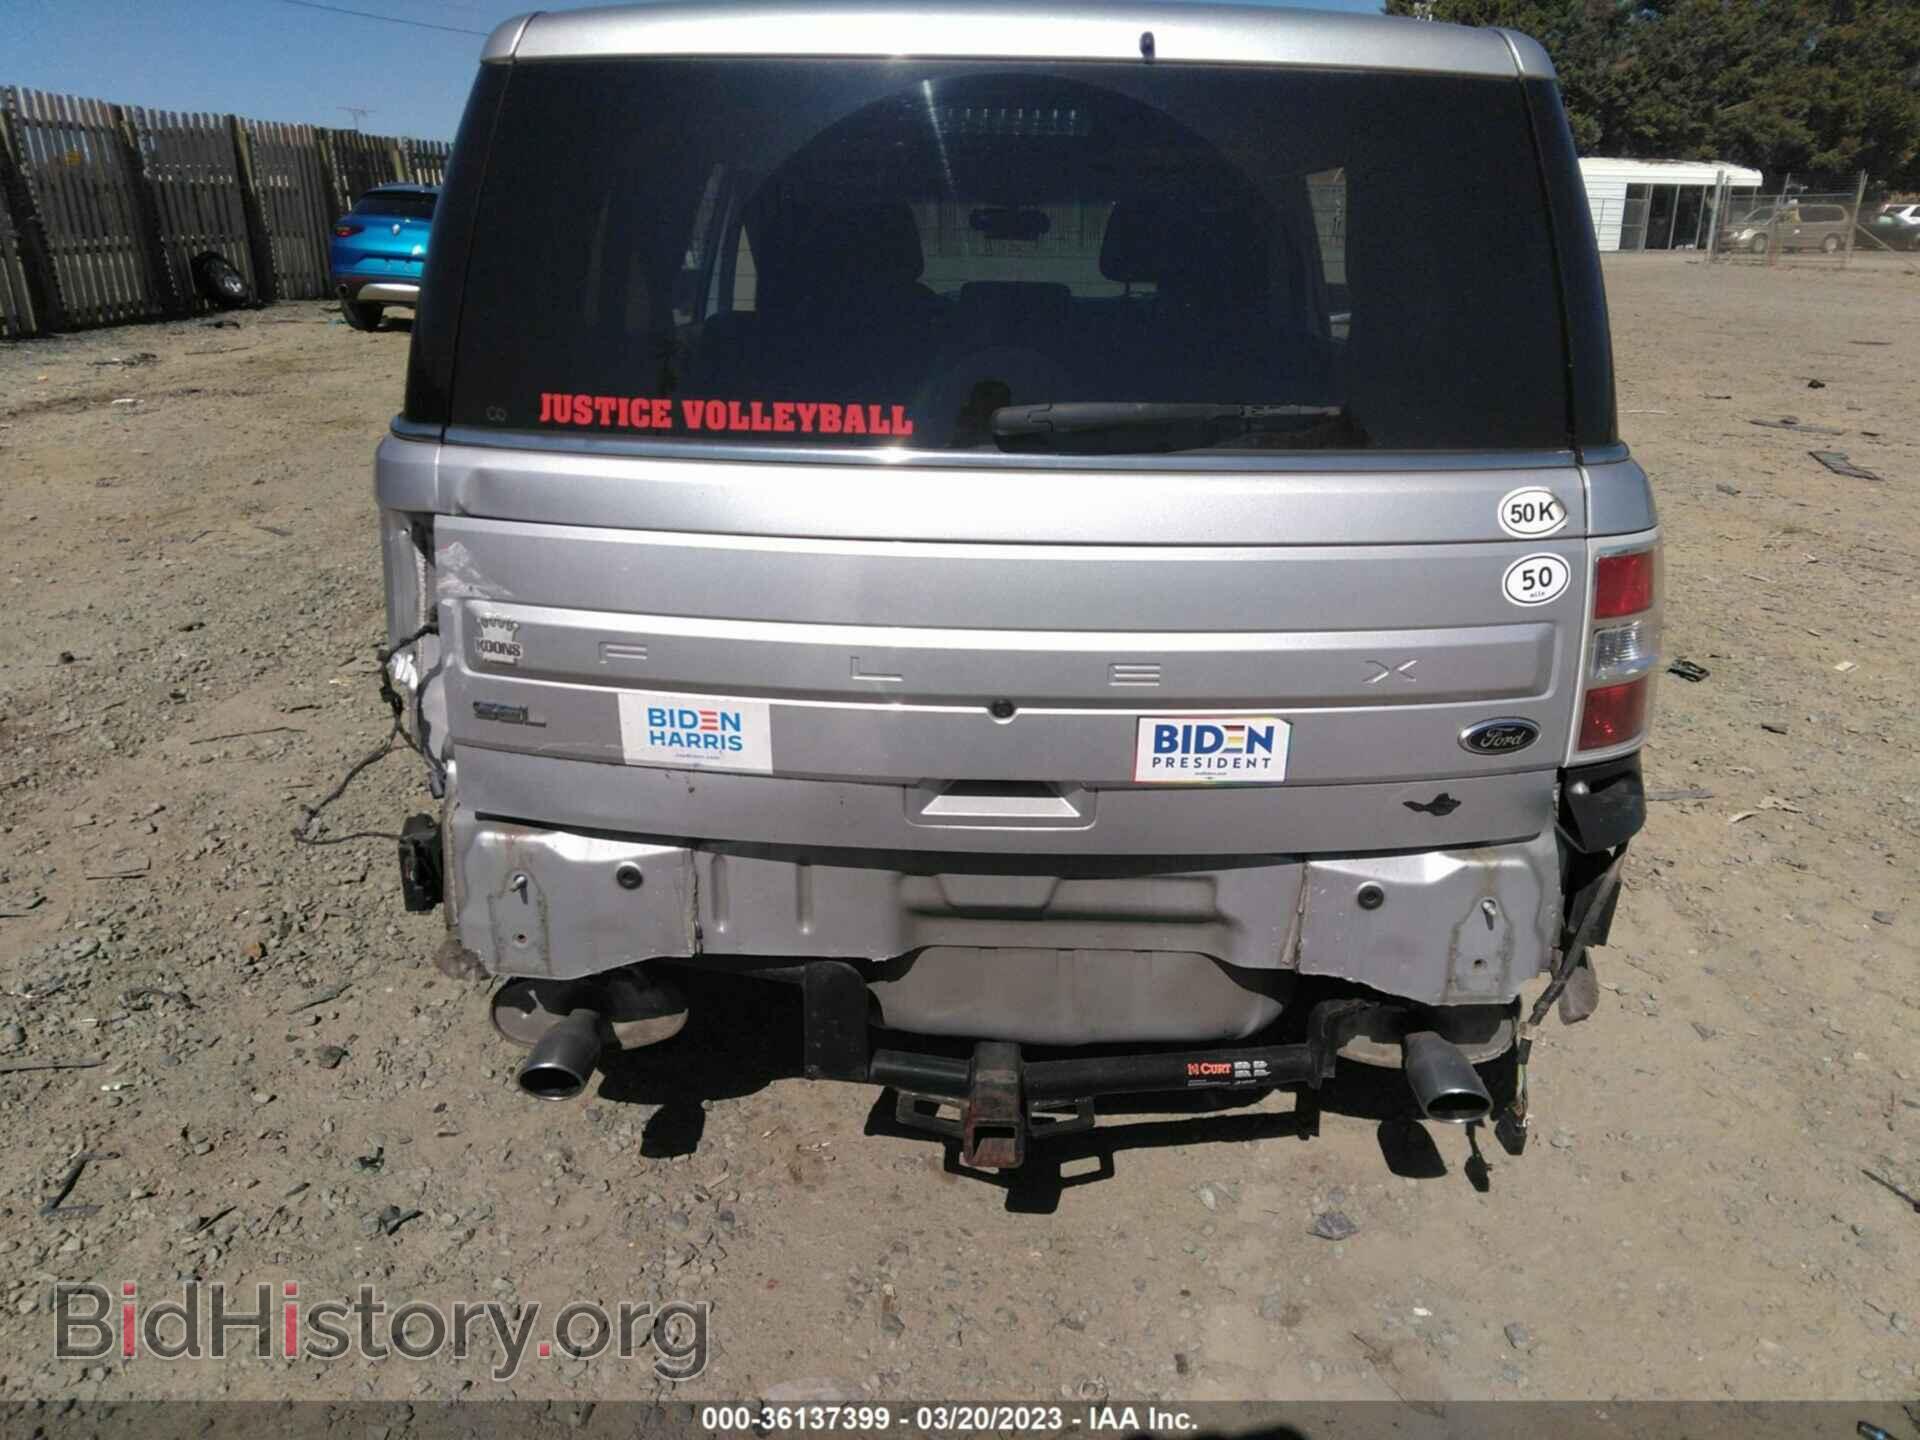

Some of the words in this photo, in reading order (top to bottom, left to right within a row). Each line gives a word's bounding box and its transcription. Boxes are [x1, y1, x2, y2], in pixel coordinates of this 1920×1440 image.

[539, 392, 673, 429] JUSTICE
[682, 400, 913, 436] VOLLEYBALL
[1522, 566, 1553, 591] 50
[647, 707, 742, 732] BIDEN
[649, 730, 743, 751] HARRIS
[1153, 724, 1275, 754] BIDEN
[1479, 727, 1527, 748] Ford
[1152, 756, 1272, 769] PRESIDENT
